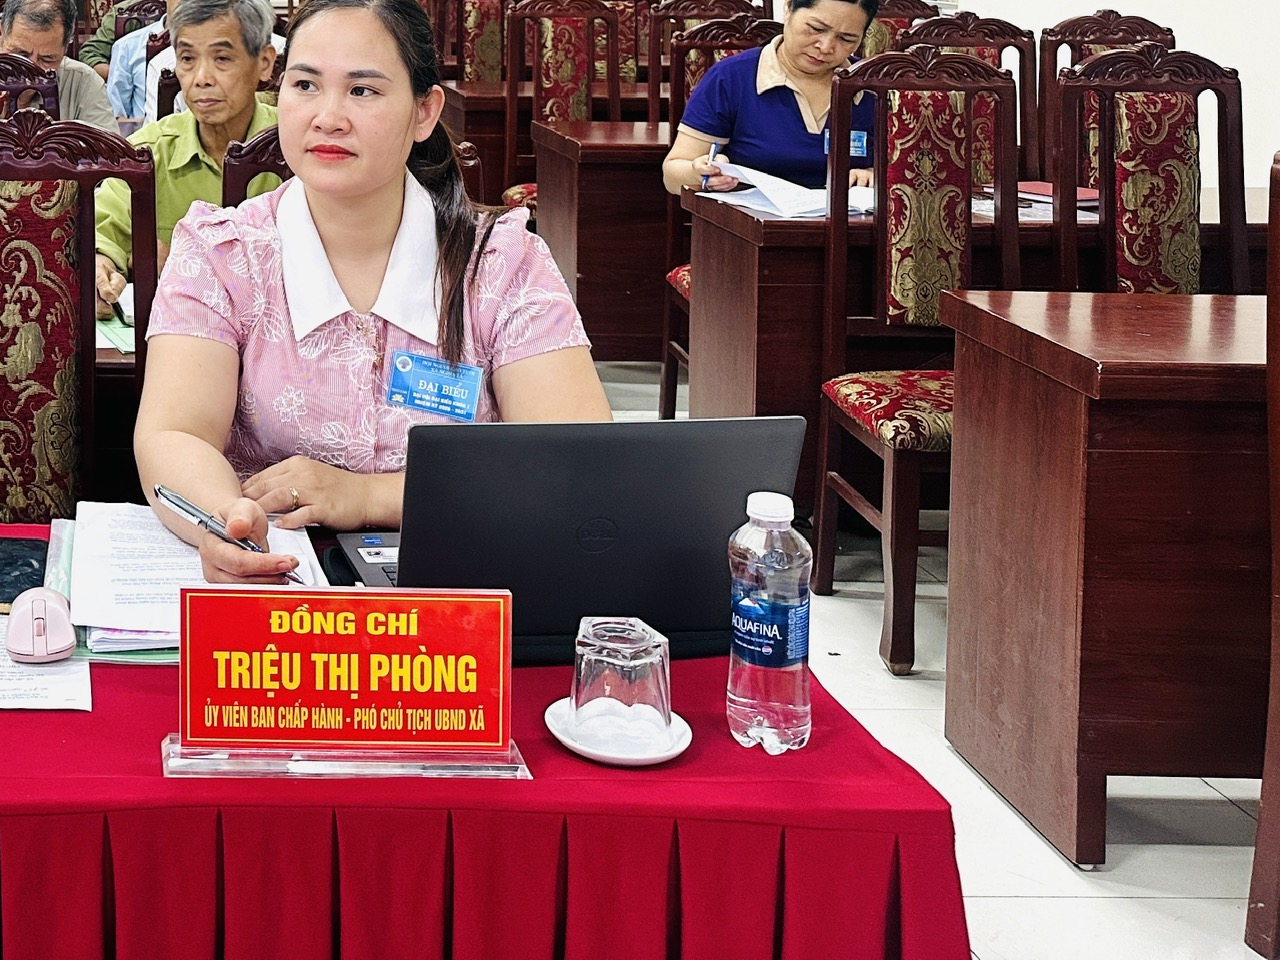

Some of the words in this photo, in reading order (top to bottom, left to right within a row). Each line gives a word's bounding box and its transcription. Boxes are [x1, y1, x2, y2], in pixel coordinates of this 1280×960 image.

[418, 380, 440, 393] ĐẠI
[441, 382, 468, 399] BIỂU
[269, 603, 356, 635] ĐỒNG
[366, 608, 418, 636] CHÍ
[213, 643, 301, 697] TRIỆU
[311, 652, 359, 700] THỊ
[370, 646, 477, 693] PHÒNG
[204, 697, 220, 728] ỦY
[222, 701, 248, 728] VIÊN
[251, 705, 275, 729] BAN
[278, 699, 308, 729] CHẤP
[312, 702, 342, 729] HÀNH
[354, 704, 377, 730] PHÓ
[380, 701, 403, 730] CHỦ
[406, 708, 431, 735] TỊCH
[435, 709, 466, 731] UBND
[469, 706, 485, 731] XÃ
